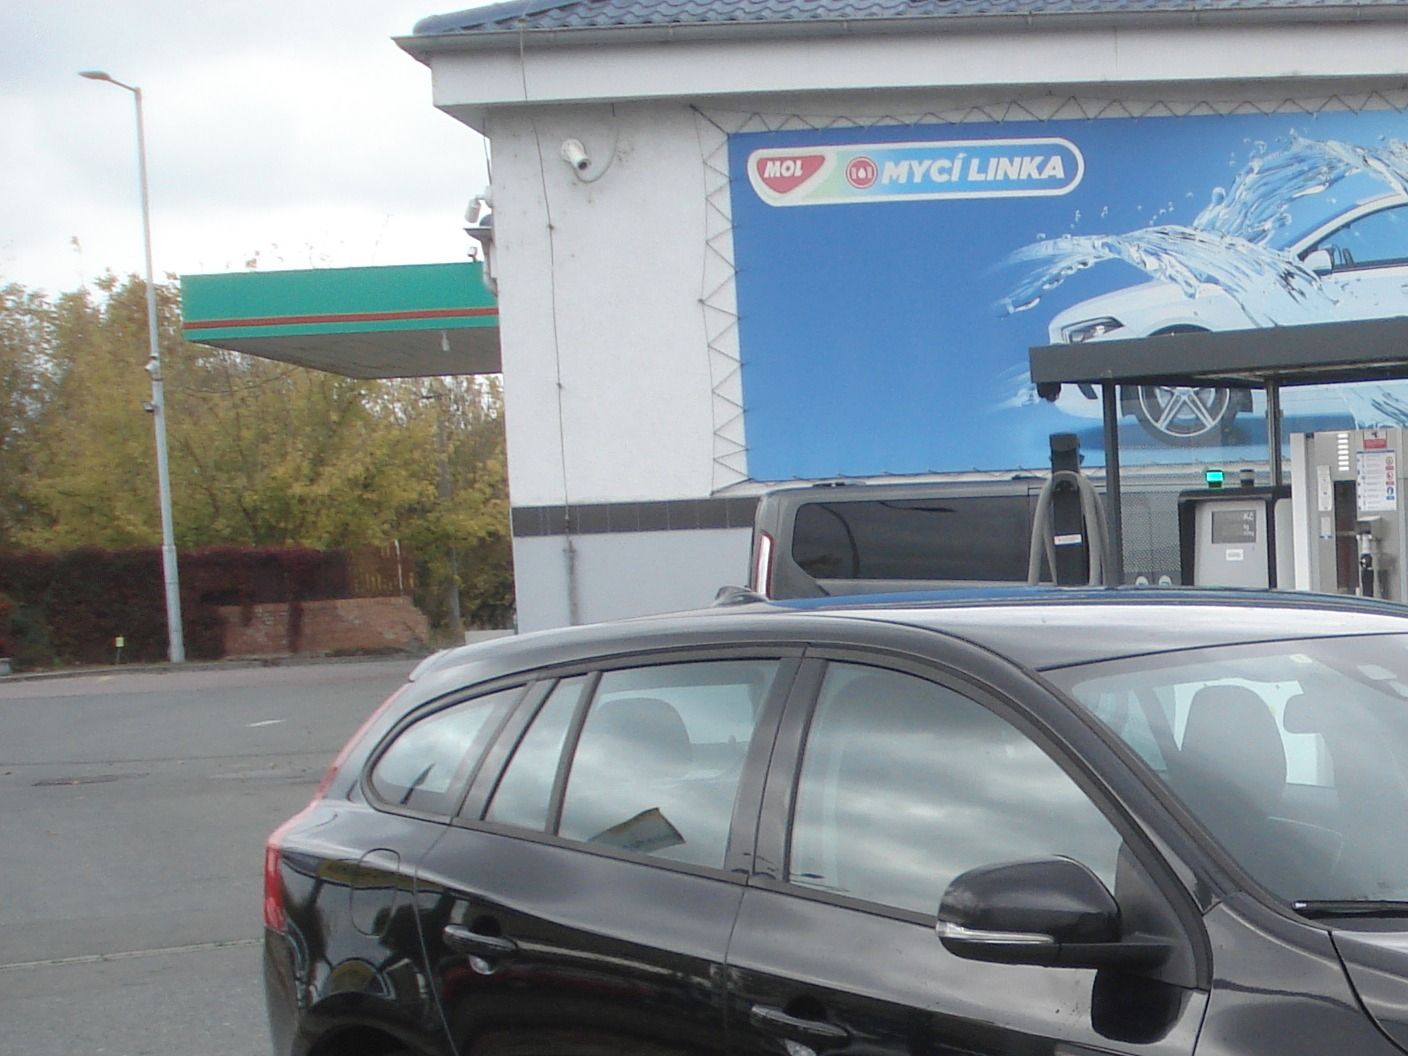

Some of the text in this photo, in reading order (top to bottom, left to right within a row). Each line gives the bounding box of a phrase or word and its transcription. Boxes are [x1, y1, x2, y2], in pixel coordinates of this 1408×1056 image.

[764, 159, 803, 178] MOL
[882, 153, 1065, 184] MYCÍ LINKA
